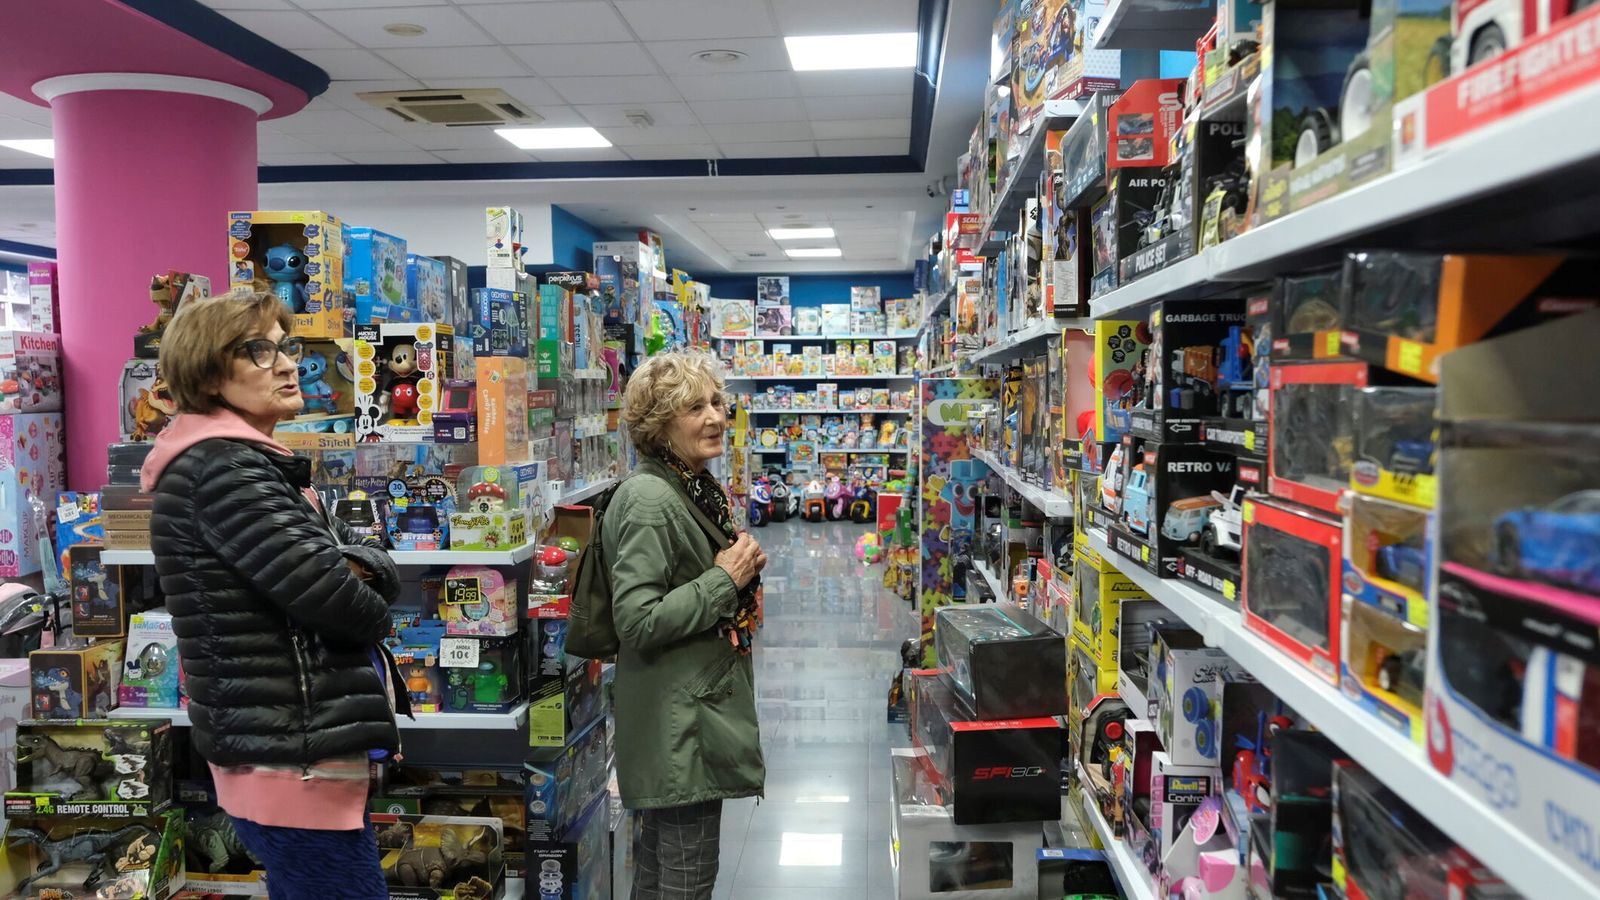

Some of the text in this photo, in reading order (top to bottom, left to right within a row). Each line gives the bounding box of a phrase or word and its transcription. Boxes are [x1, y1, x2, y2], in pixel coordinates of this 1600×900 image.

[1129, 179, 1148, 188] AIR
[1136, 242, 1167, 273] POLICE SET
[548, 274, 582, 285] perplexus
[1165, 313, 1216, 323] GARBAGE
[21, 335, 57, 351] Kitchen
[482, 389, 491, 411] Candy
[1167, 462, 1213, 473] RETRO
[355, 477, 387, 488] Harry Potter
[392, 483, 402, 491] 30
[1170, 779, 1199, 791] Revell
[57, 804, 90, 815] REMOTE
[91, 803, 130, 814] CONTROL
